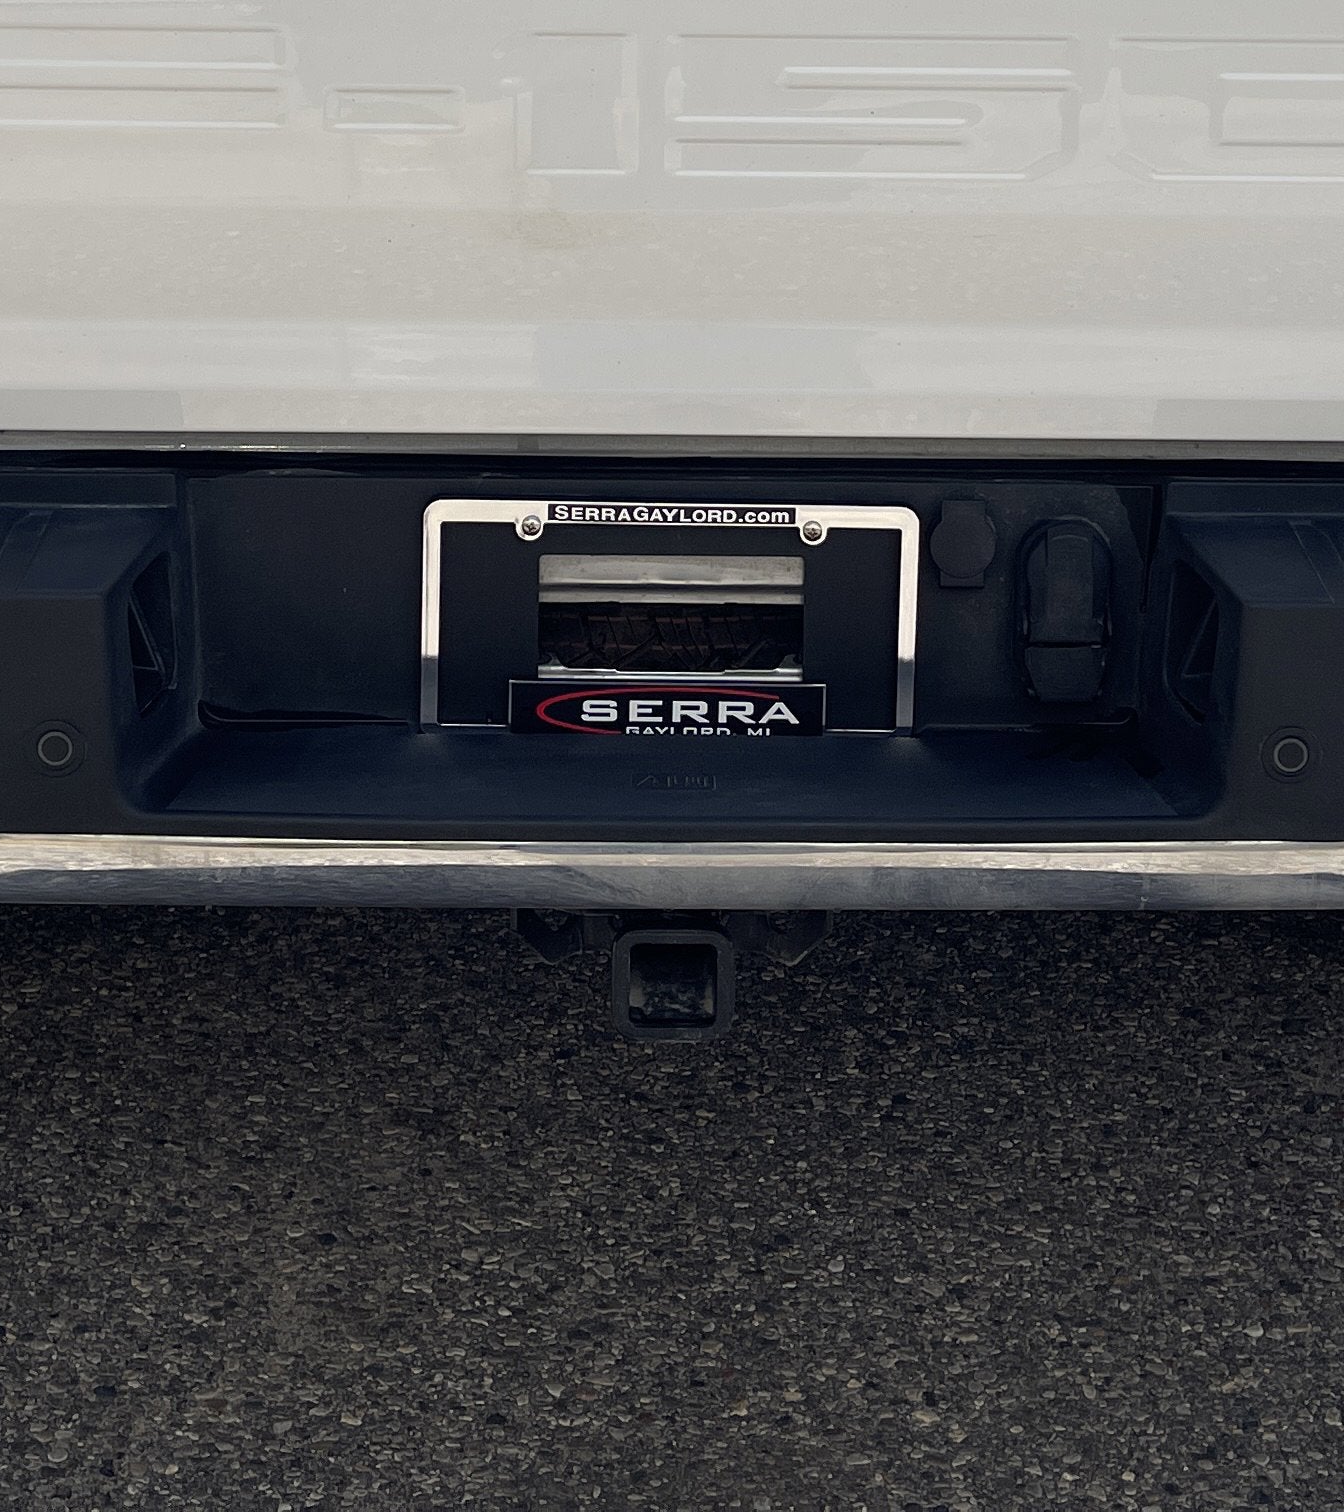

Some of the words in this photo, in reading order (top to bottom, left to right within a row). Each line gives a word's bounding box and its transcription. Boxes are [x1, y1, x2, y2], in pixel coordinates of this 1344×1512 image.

[554, 505, 790, 524] SERRAGAYLORD.com
[580, 699, 800, 725] SERRA
[747, 727, 771, 737] MI
